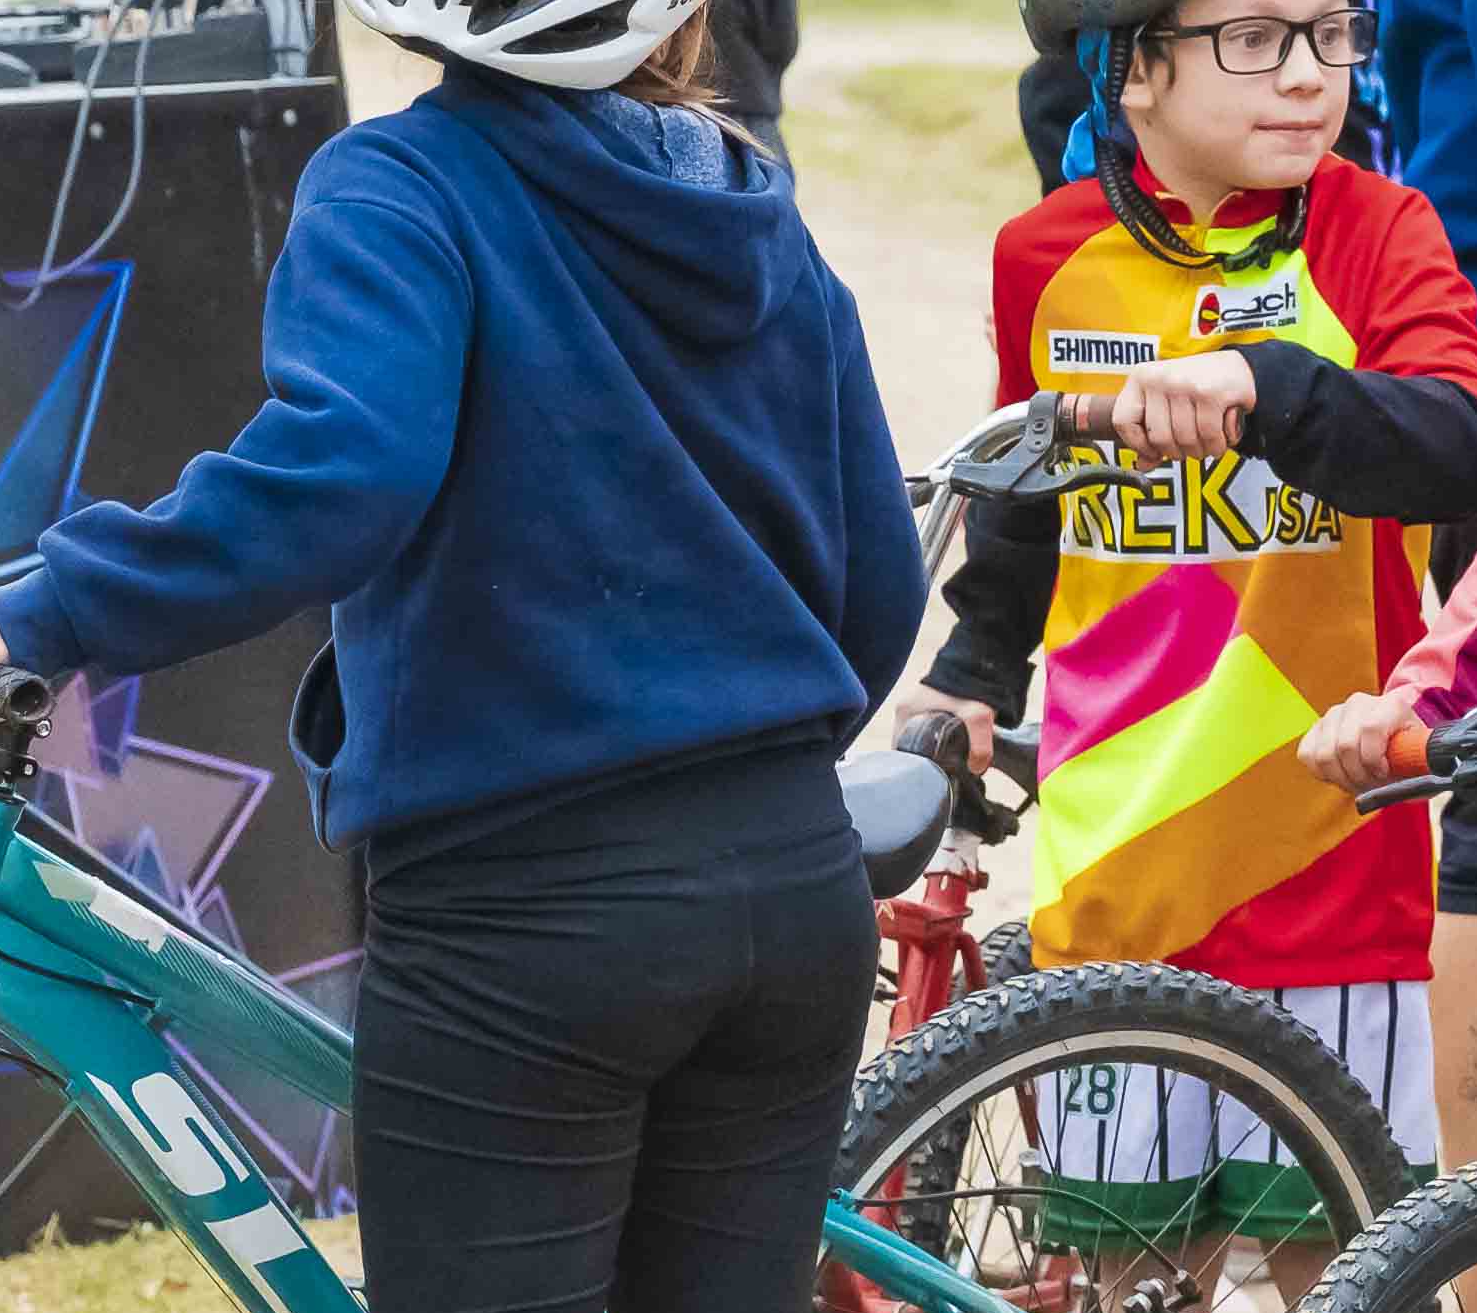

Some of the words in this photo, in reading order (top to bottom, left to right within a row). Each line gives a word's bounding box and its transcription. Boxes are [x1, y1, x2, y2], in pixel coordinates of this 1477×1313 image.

[1053, 337, 1156, 365] SHIMANO
[1056, 446, 1262, 554] REK
[1064, 1063, 1116, 1115] 28
